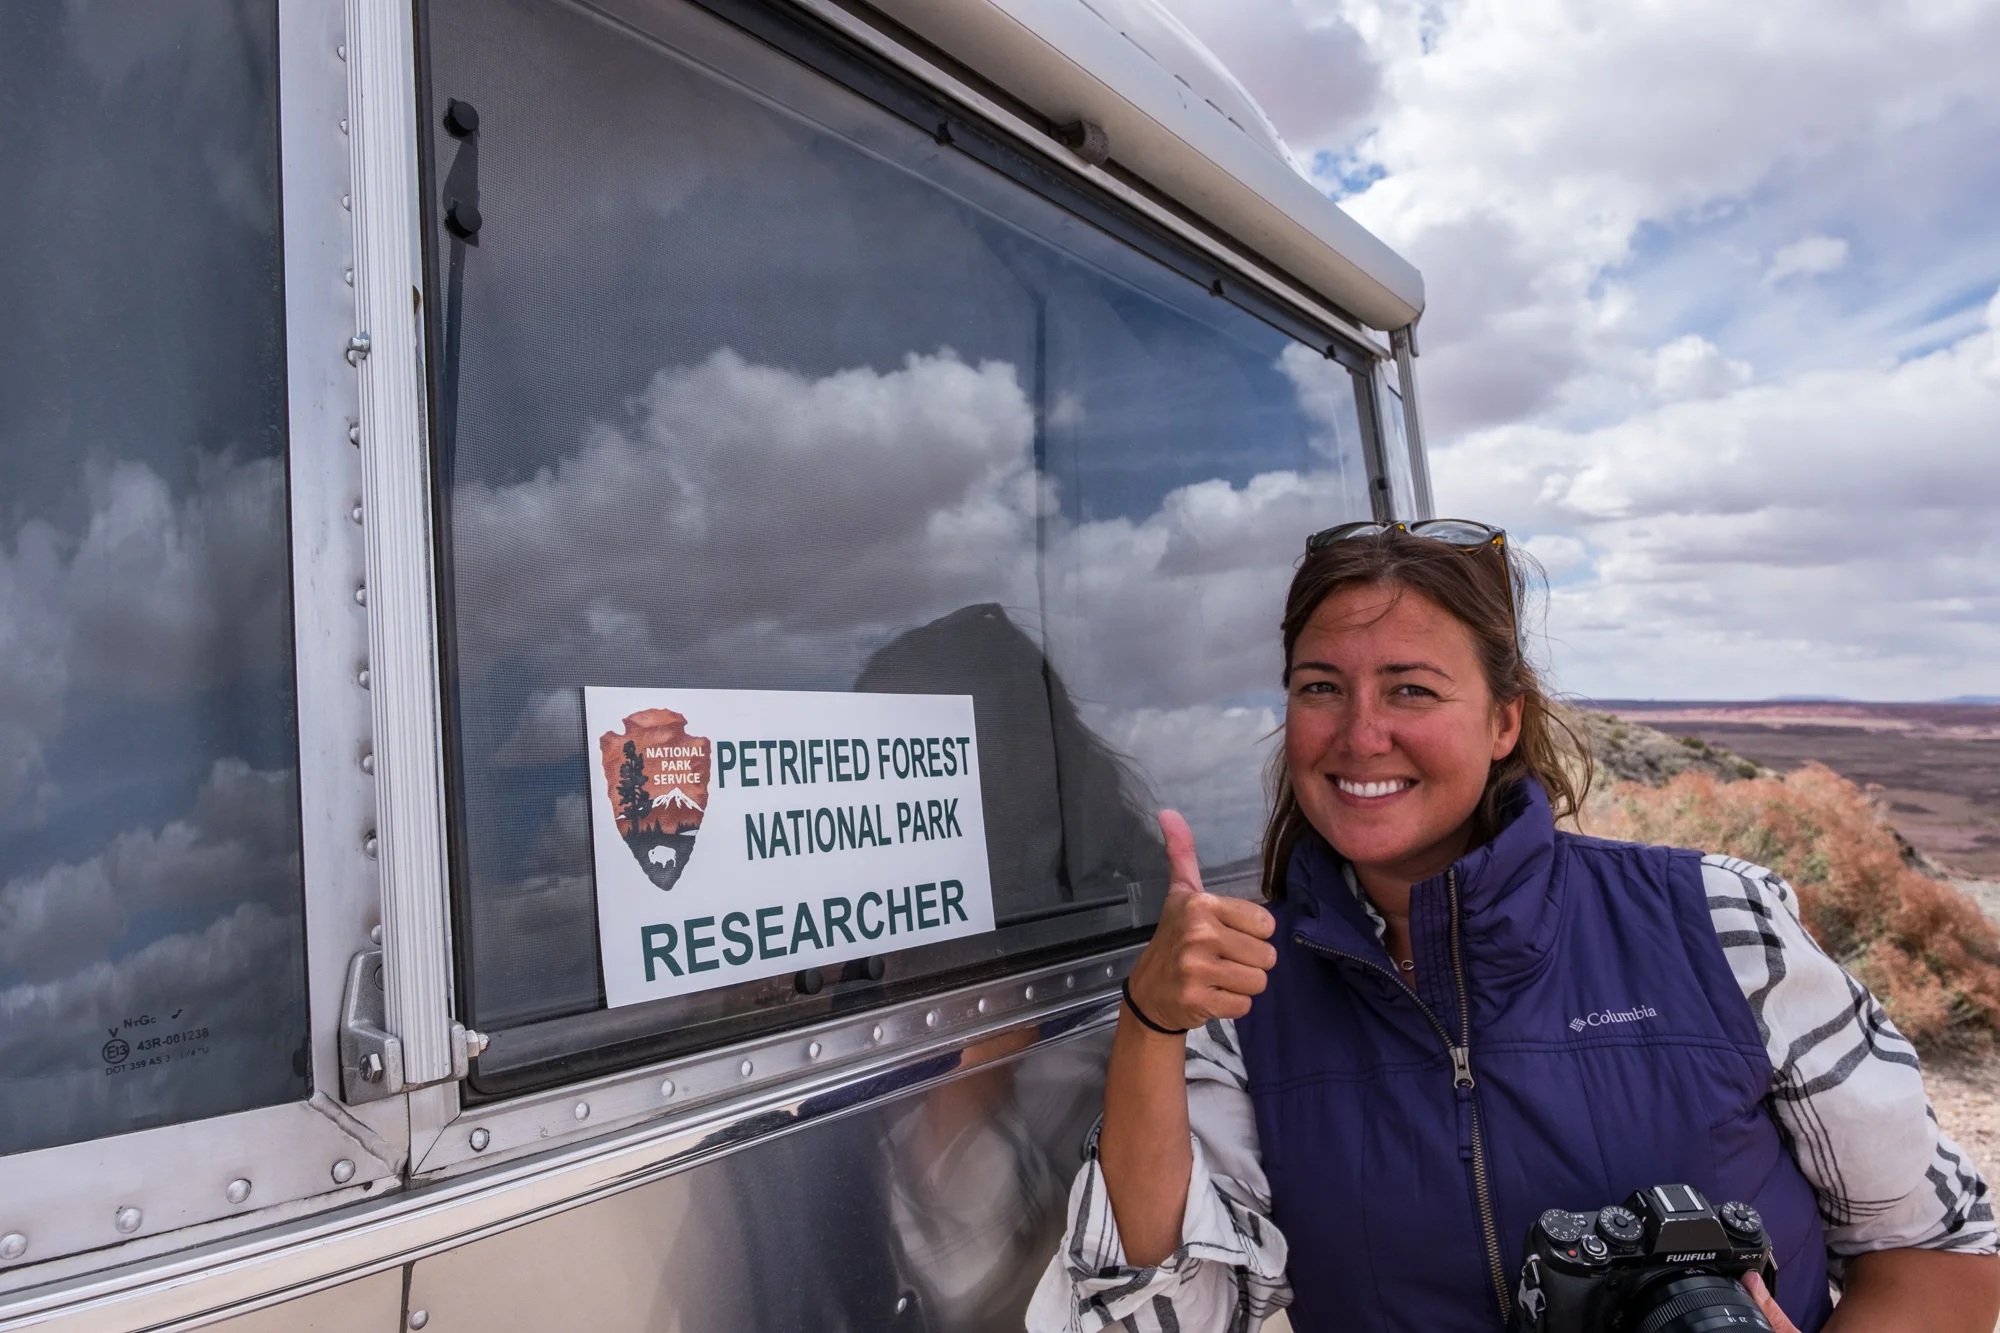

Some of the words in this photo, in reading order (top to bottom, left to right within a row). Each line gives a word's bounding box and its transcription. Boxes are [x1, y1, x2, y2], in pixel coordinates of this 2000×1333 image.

[646, 746, 705, 758] NATIONAL
[717, 738, 870, 788] PETRIFIED
[878, 736, 971, 780] FOREST
[661, 759, 692, 771] PARK
[653, 773, 701, 785] SERVICE
[745, 803, 892, 861] NATIONAL
[898, 798, 962, 844] PARK
[641, 879, 969, 982] RESEARCHER
[1587, 1004, 1657, 1027] Columbia
[136, 1027, 209, 1051] 43R-001238
[105, 1064, 127, 1076] DOT
[149, 1056, 162, 1066] AS
[1666, 1252, 1717, 1262] FUJIFILM
